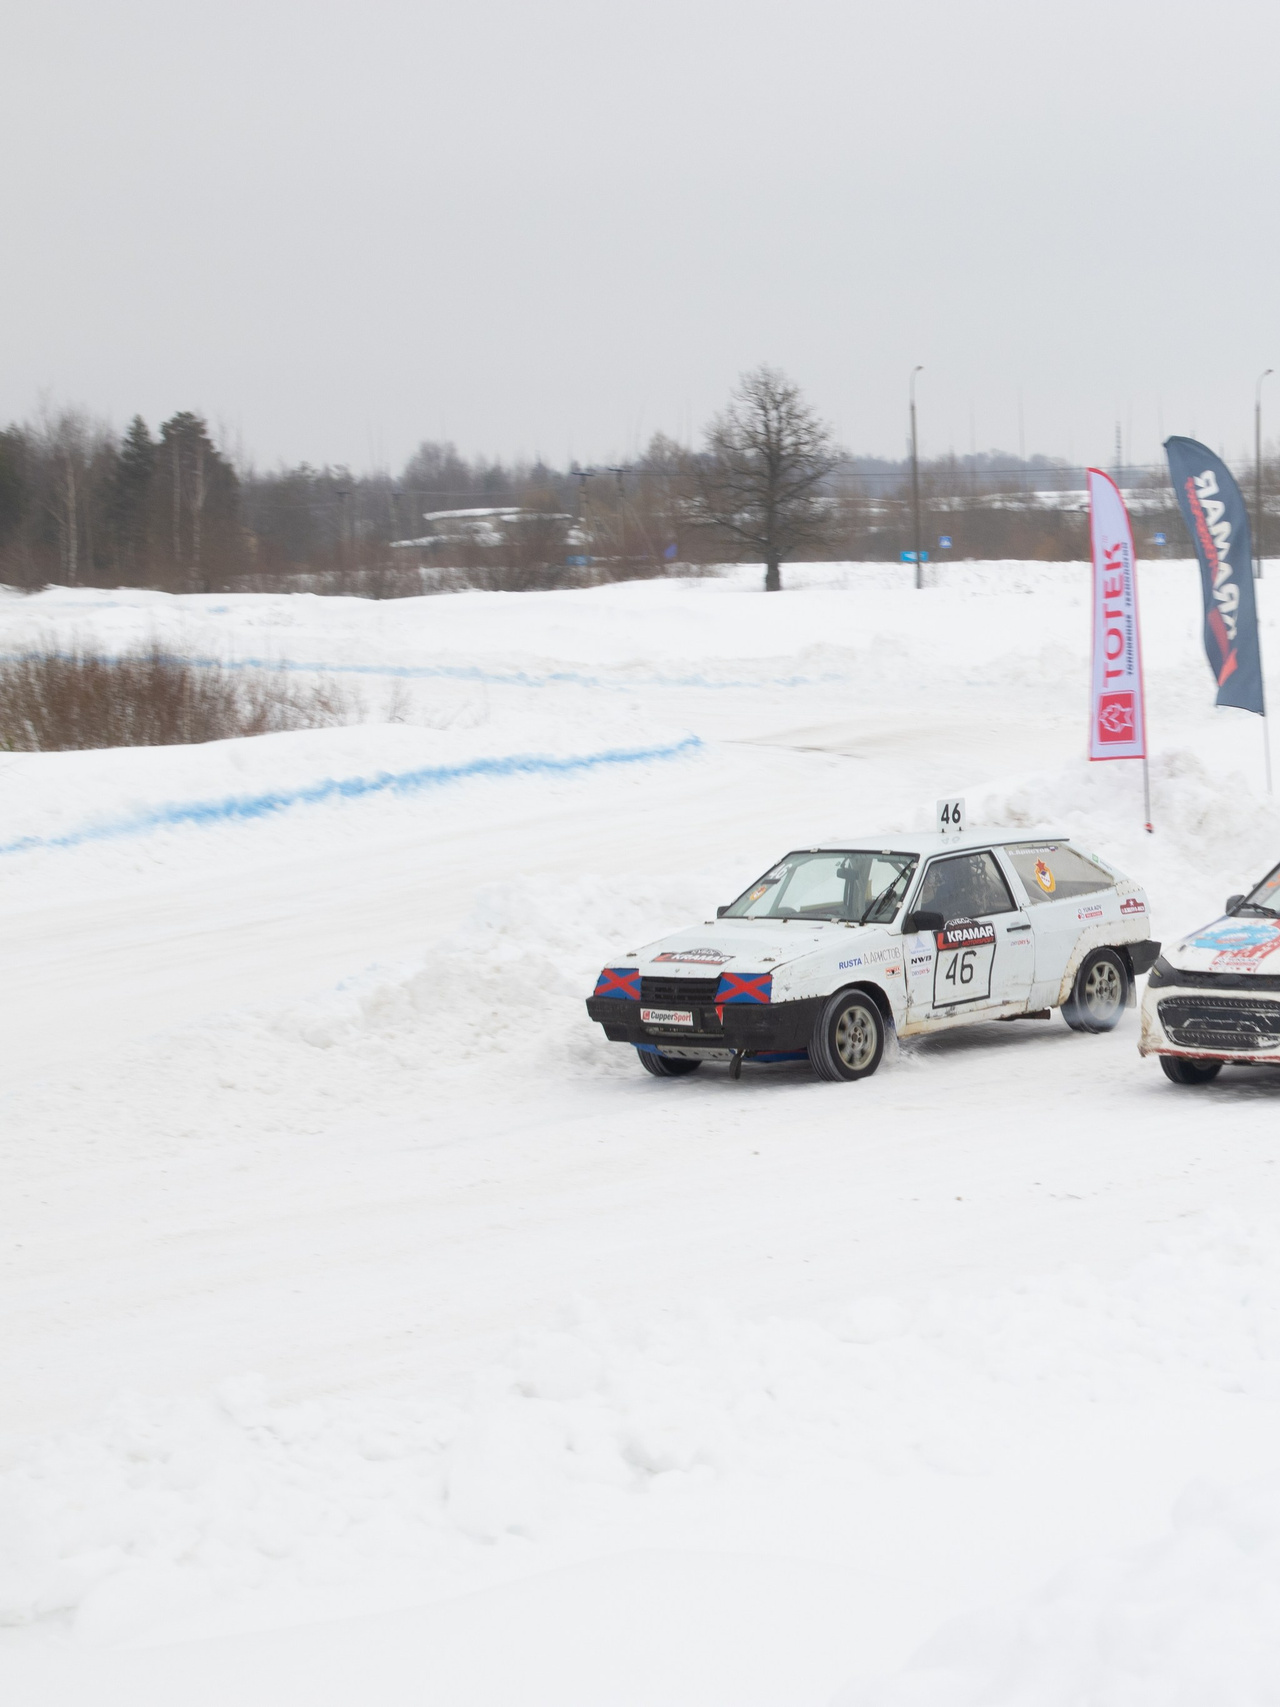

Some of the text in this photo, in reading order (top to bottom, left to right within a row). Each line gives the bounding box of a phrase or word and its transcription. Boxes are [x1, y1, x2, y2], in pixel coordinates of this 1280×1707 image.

[941, 803, 961, 824] 46
[947, 925, 994, 942] KRAMAR
[839, 957, 862, 970] RUSTA
[946, 950, 977, 986] 46
[650, 1011, 692, 1023] CupperSport
